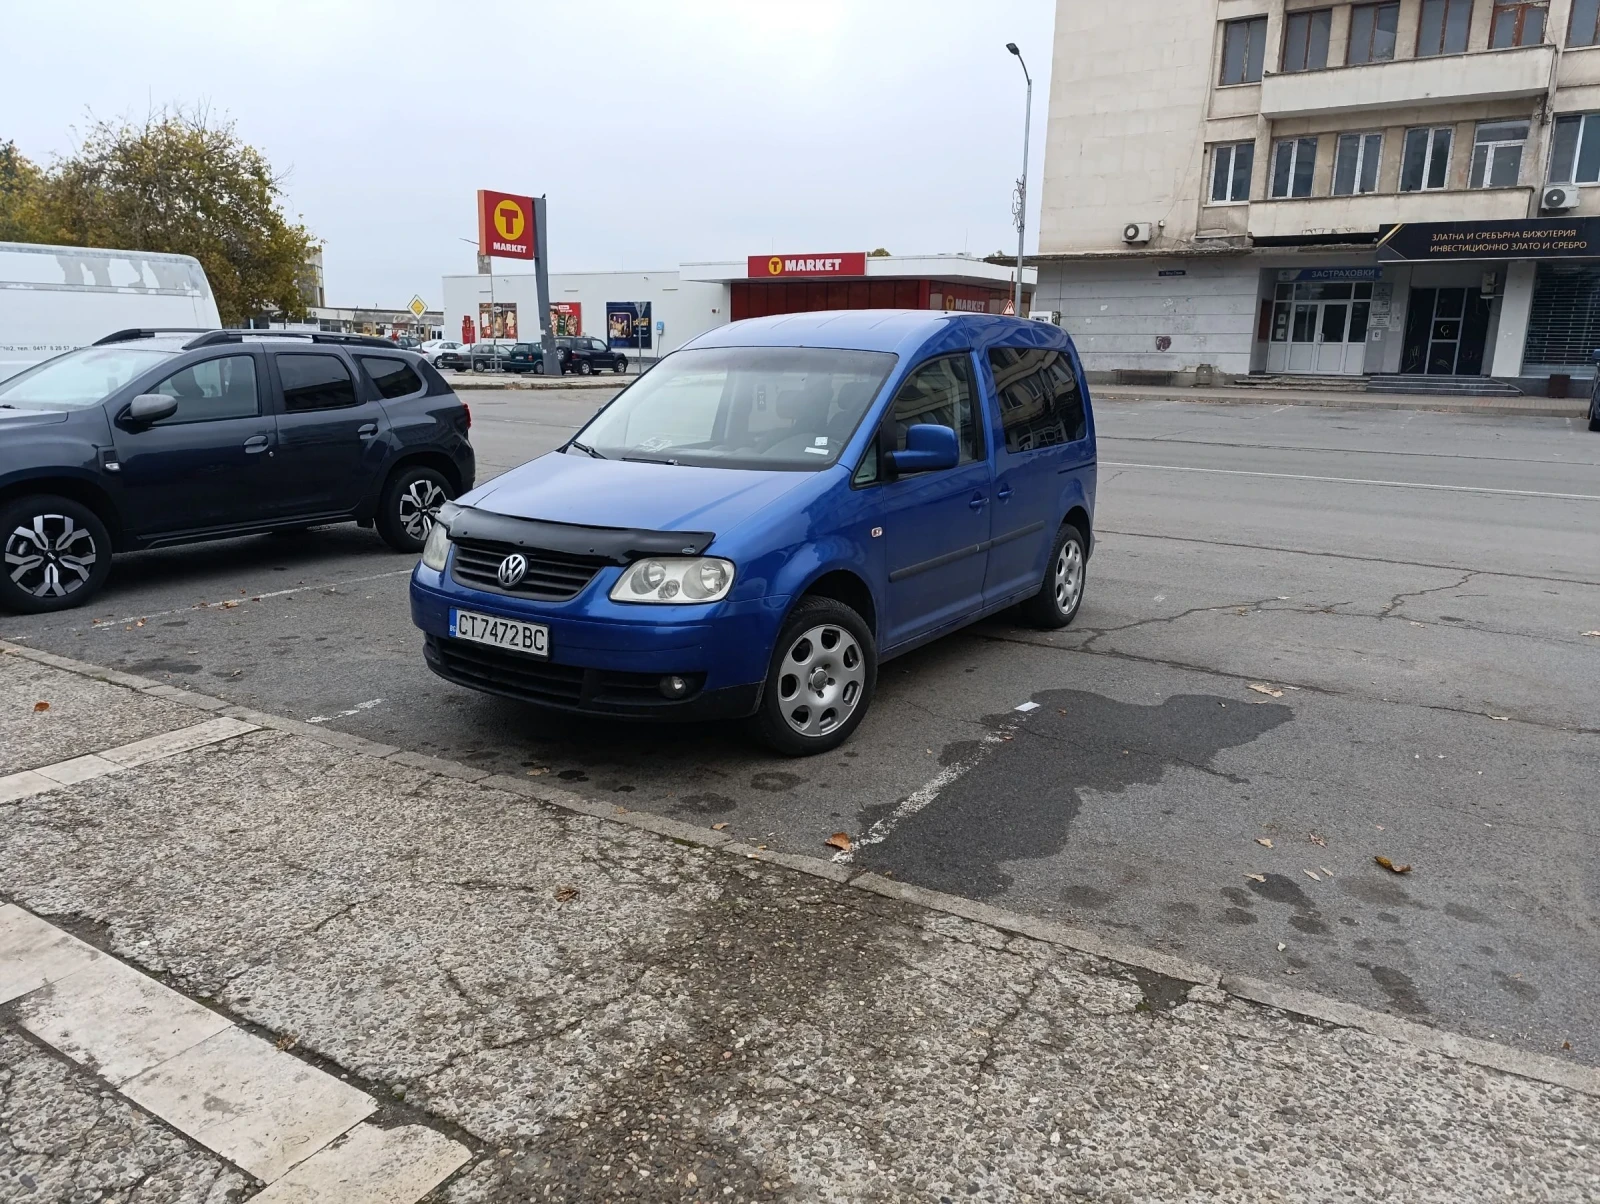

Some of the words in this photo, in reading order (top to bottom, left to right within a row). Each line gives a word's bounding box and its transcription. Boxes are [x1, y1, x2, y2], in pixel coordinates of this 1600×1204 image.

[500, 208, 519, 234] T
[1431, 233, 1464, 242] ЗЛАТНА
[1466, 232, 1474, 240] И
[1475, 231, 1521, 240] СРЕБЪРНА
[1522, 229, 1577, 239] БИЖУТЕРИЯ
[493, 242, 526, 253] MARKET
[1430, 243, 1509, 253] ИНВЕСТИЦИОННО
[1511, 242, 1540, 251] ЗЛАТО
[1542, 241, 1550, 250] И
[1552, 241, 1587, 250] СРЕБРО
[785, 259, 841, 271] MARKET
[1311, 269, 1375, 278] ЗАСТРАХОВКИ
[955, 298, 985, 312] MARKET
